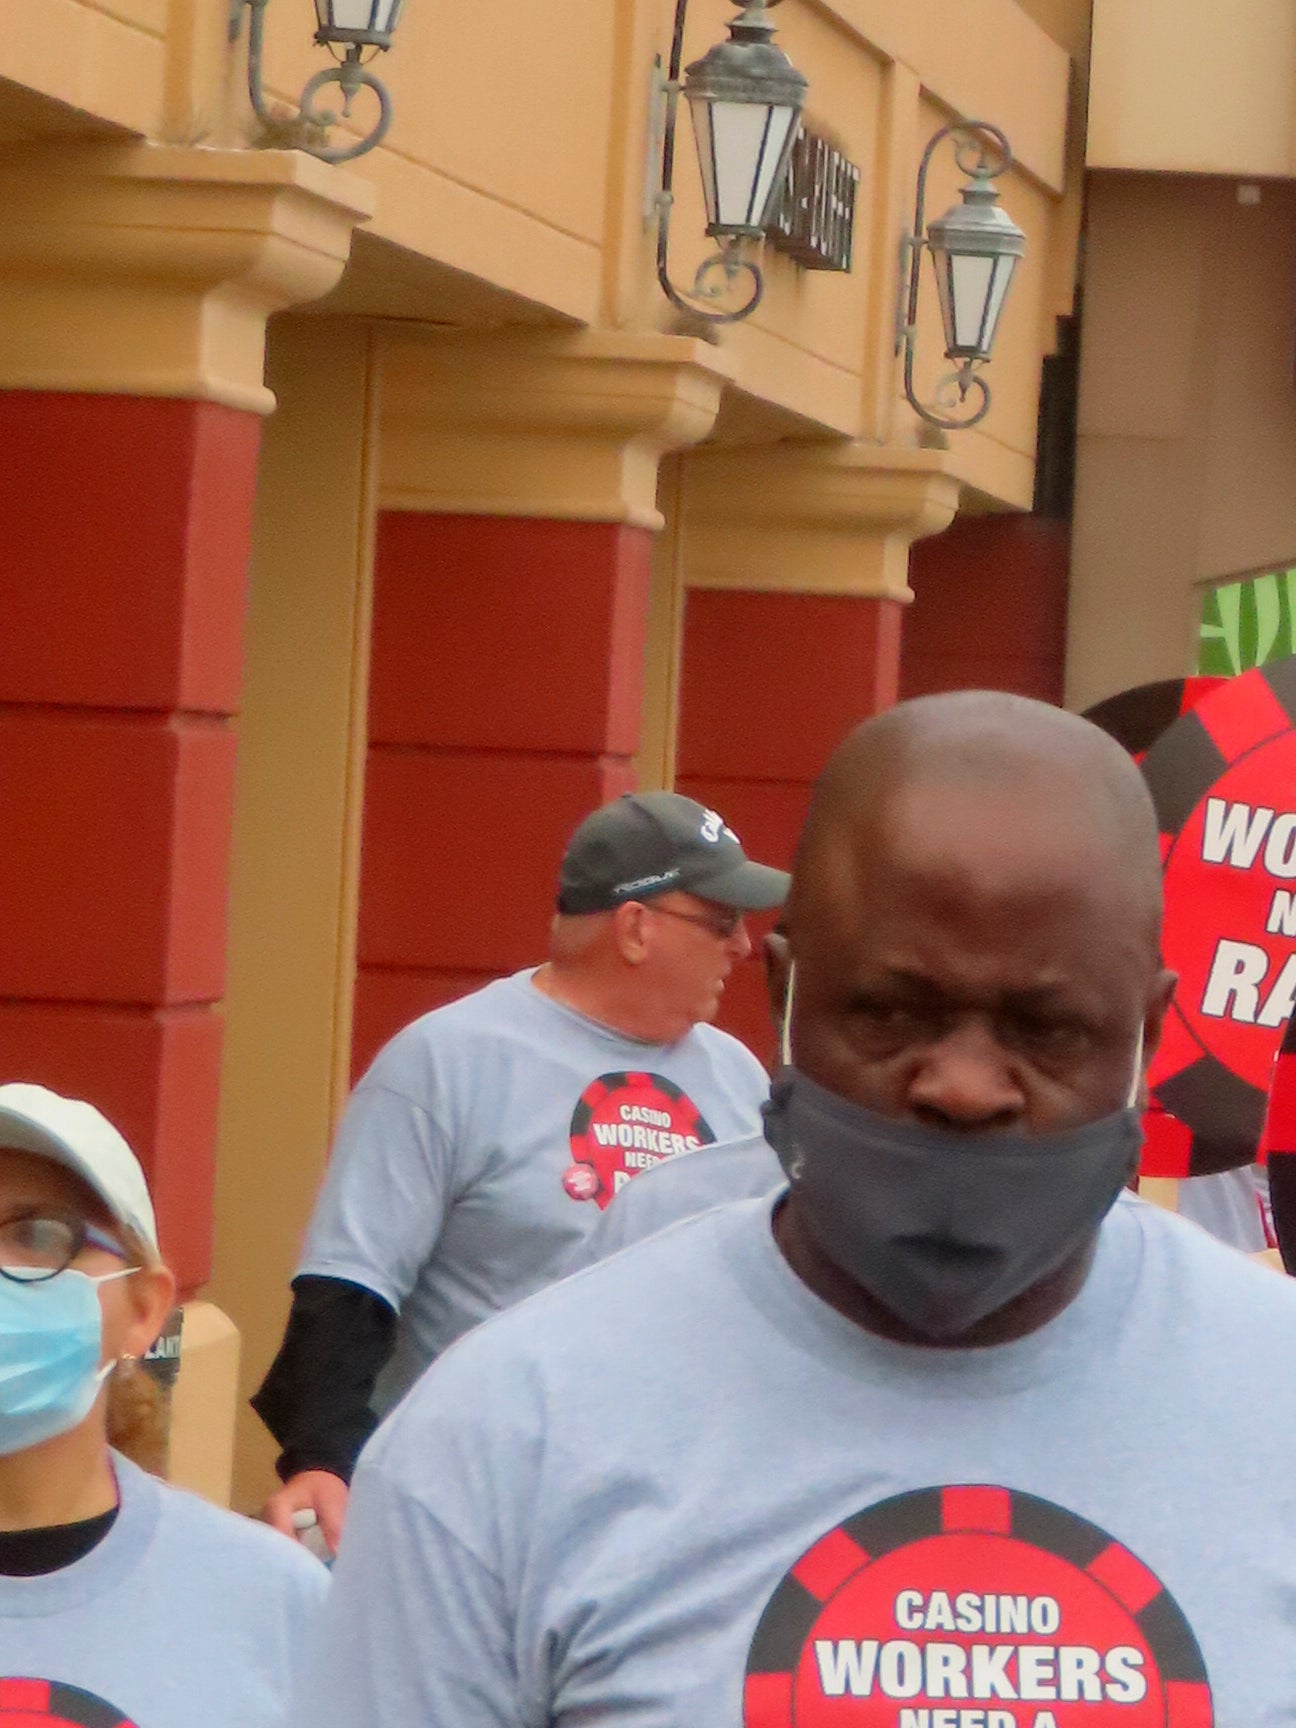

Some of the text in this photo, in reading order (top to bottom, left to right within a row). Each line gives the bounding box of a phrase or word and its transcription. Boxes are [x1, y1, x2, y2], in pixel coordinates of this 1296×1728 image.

[619, 1104, 672, 1128] CASINO
[895, 1589, 1060, 1634] CASINO
[814, 1639, 1148, 1704] WORKERS
